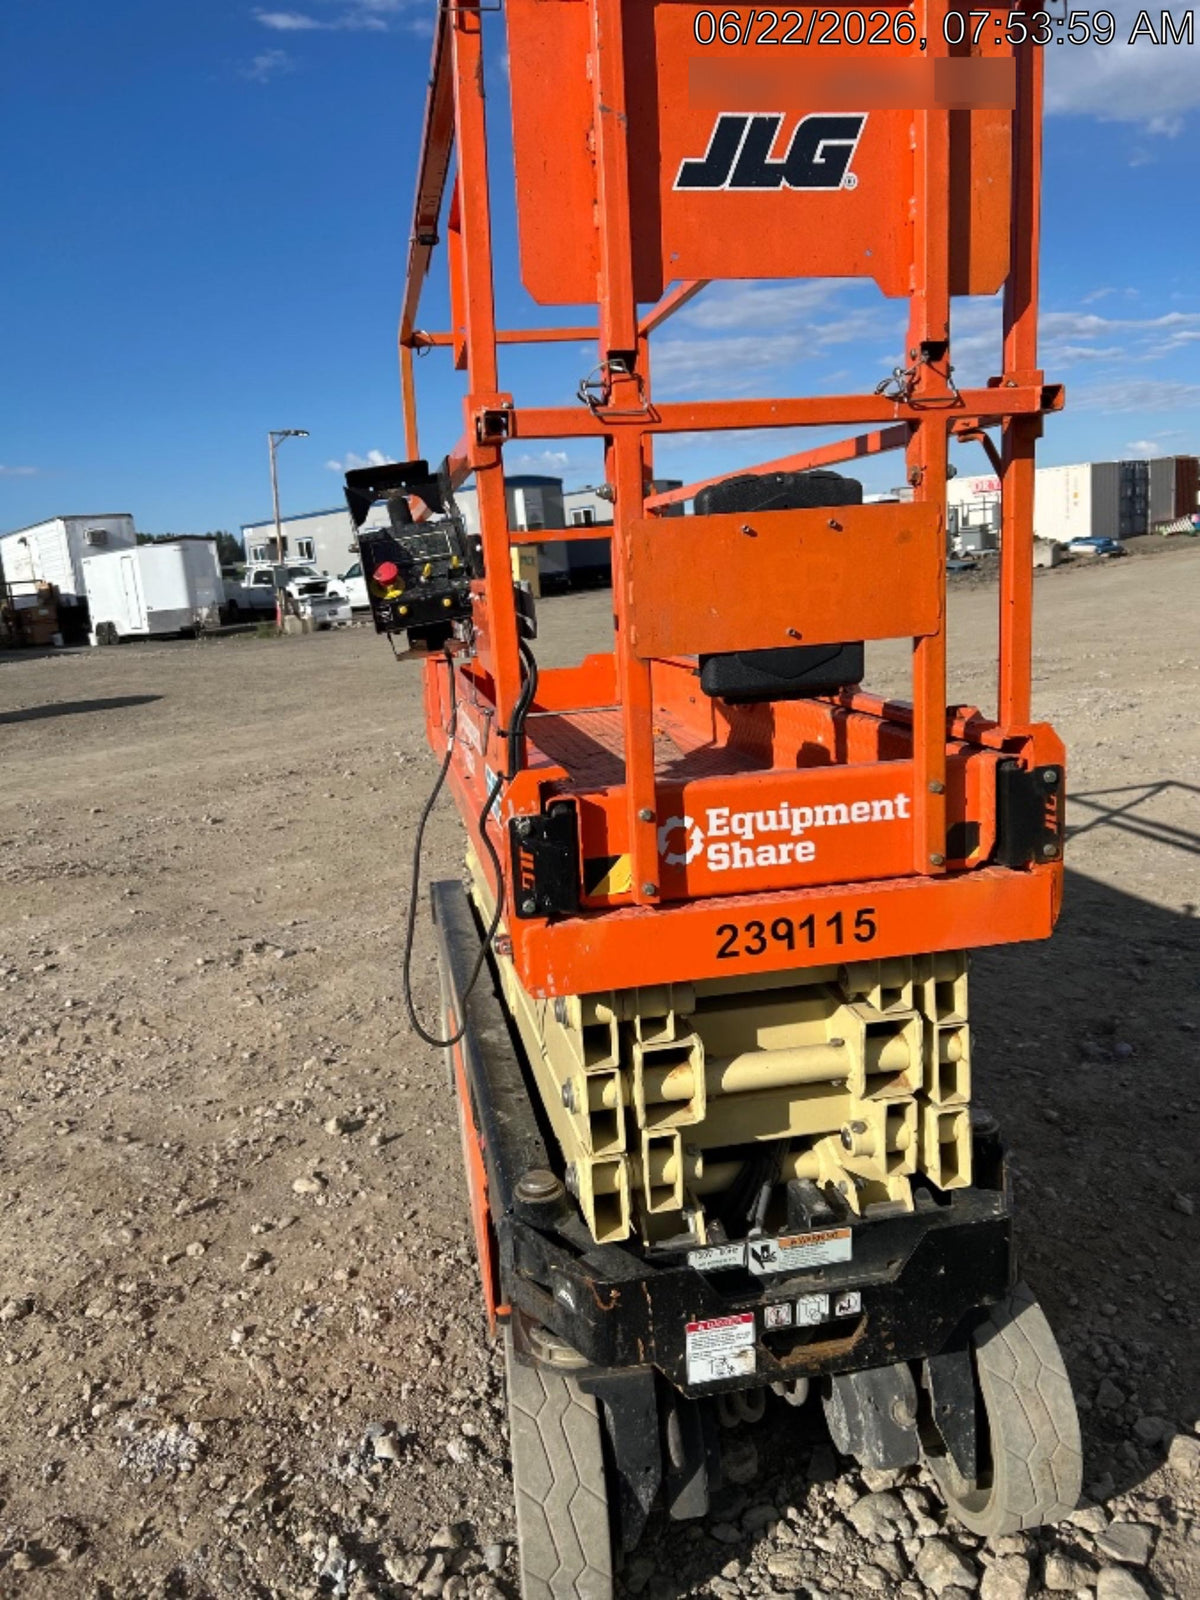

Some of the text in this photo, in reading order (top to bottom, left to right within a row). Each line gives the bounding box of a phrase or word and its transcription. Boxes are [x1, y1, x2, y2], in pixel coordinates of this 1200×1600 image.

[672, 112, 870, 191] JLG
[706, 793, 911, 840] Equipment
[518, 846, 535, 891] JLG
[707, 841, 816, 872] Share
[716, 908, 877, 960] 239115
